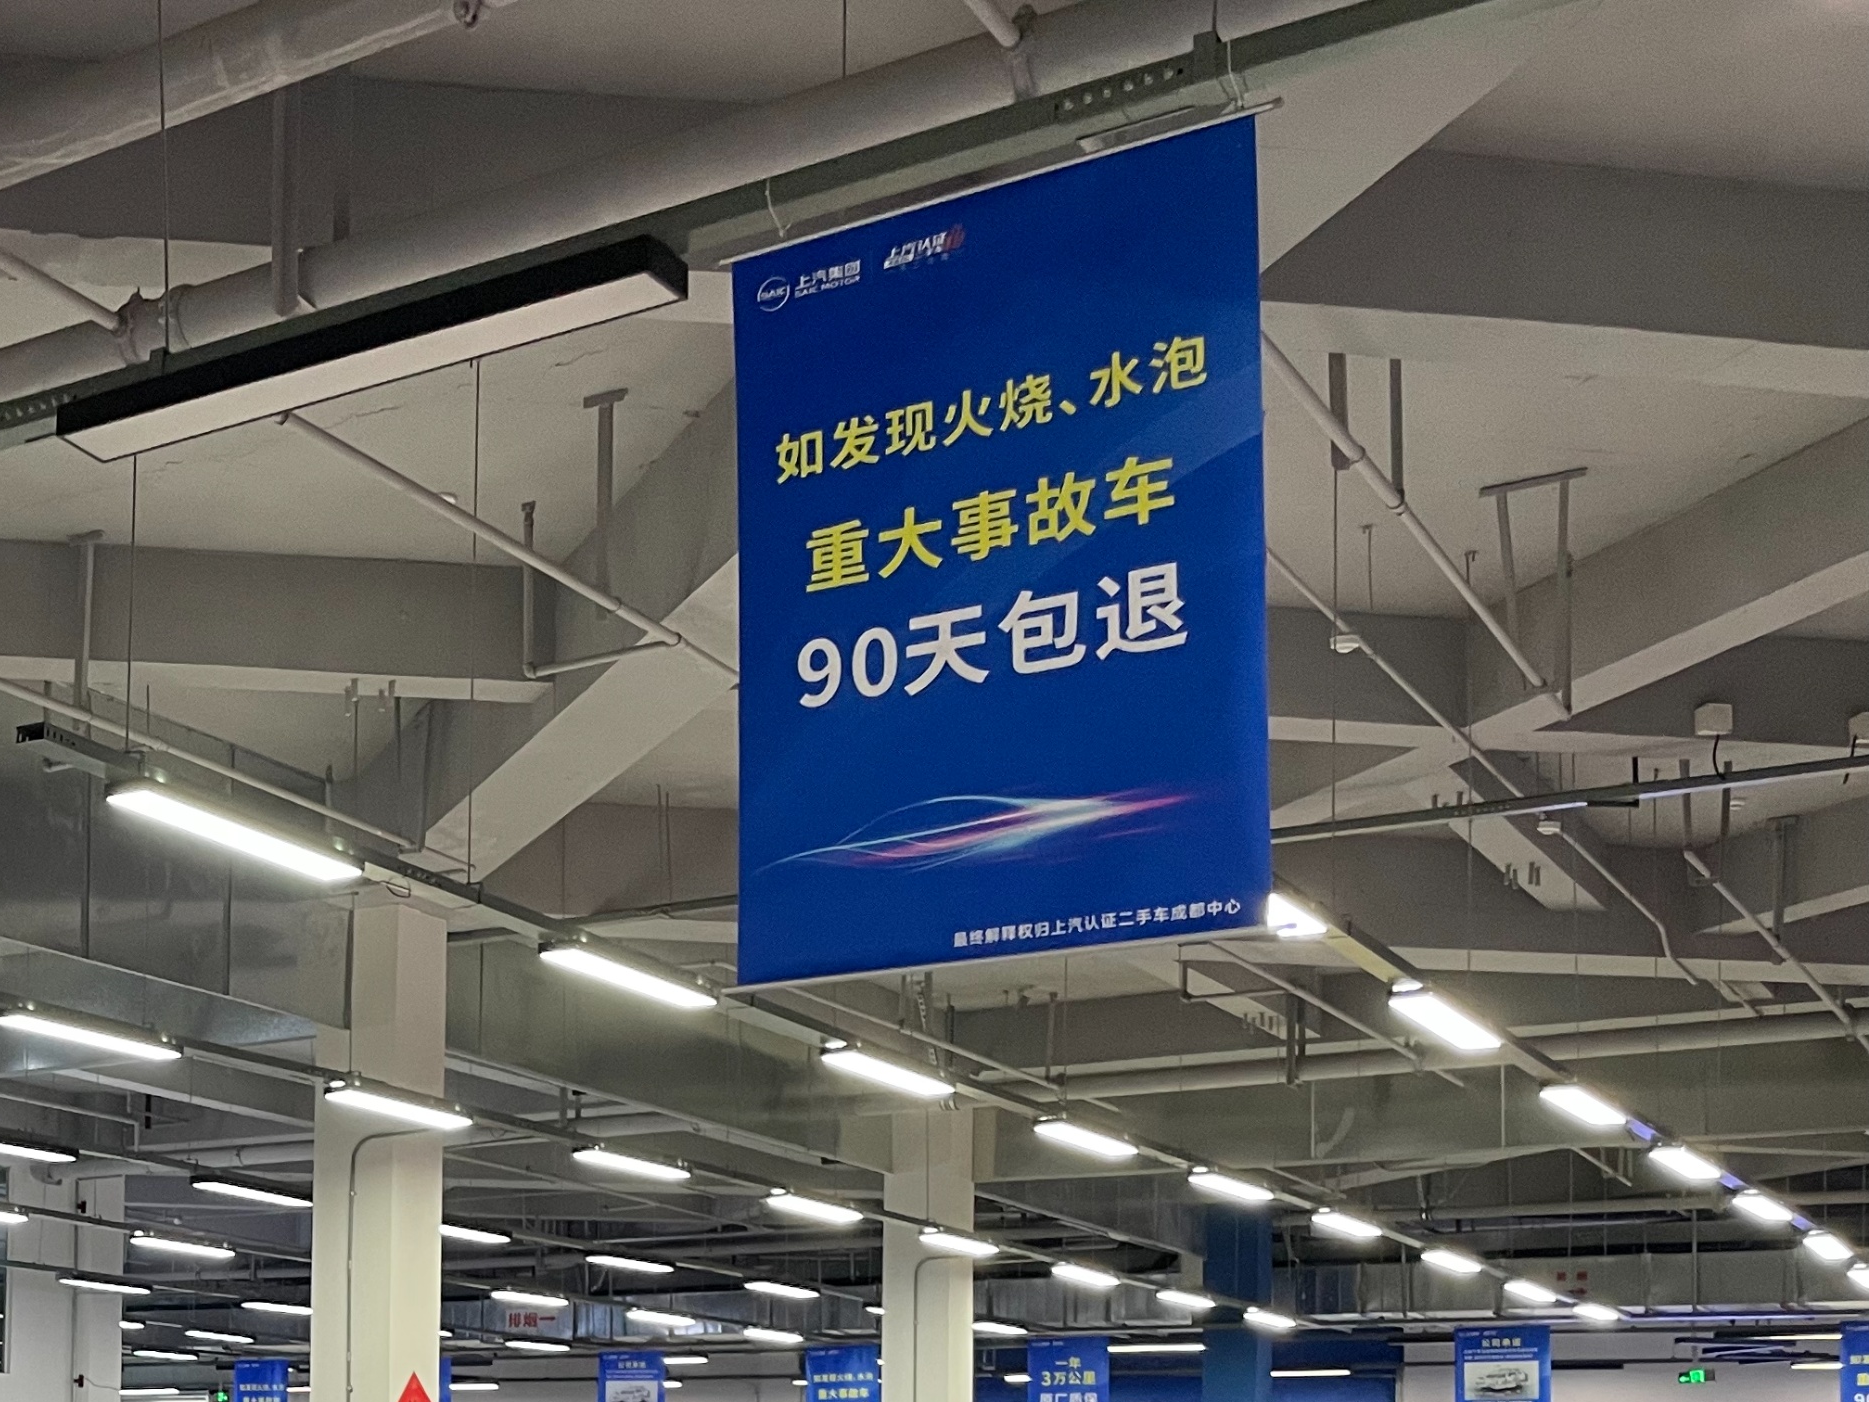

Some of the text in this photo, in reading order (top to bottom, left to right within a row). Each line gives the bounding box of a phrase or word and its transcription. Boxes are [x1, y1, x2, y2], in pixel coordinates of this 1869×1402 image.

[775, 335, 1207, 483] 如发现火烧、水泡
[805, 455, 1177, 593] 重大事故车
[797, 562, 1188, 708] 90天包退
[953, 899, 1241, 947] 最终解释权归上汽认证二手车成都中心
[1041, 1370, 1096, 1386] 3万公里
